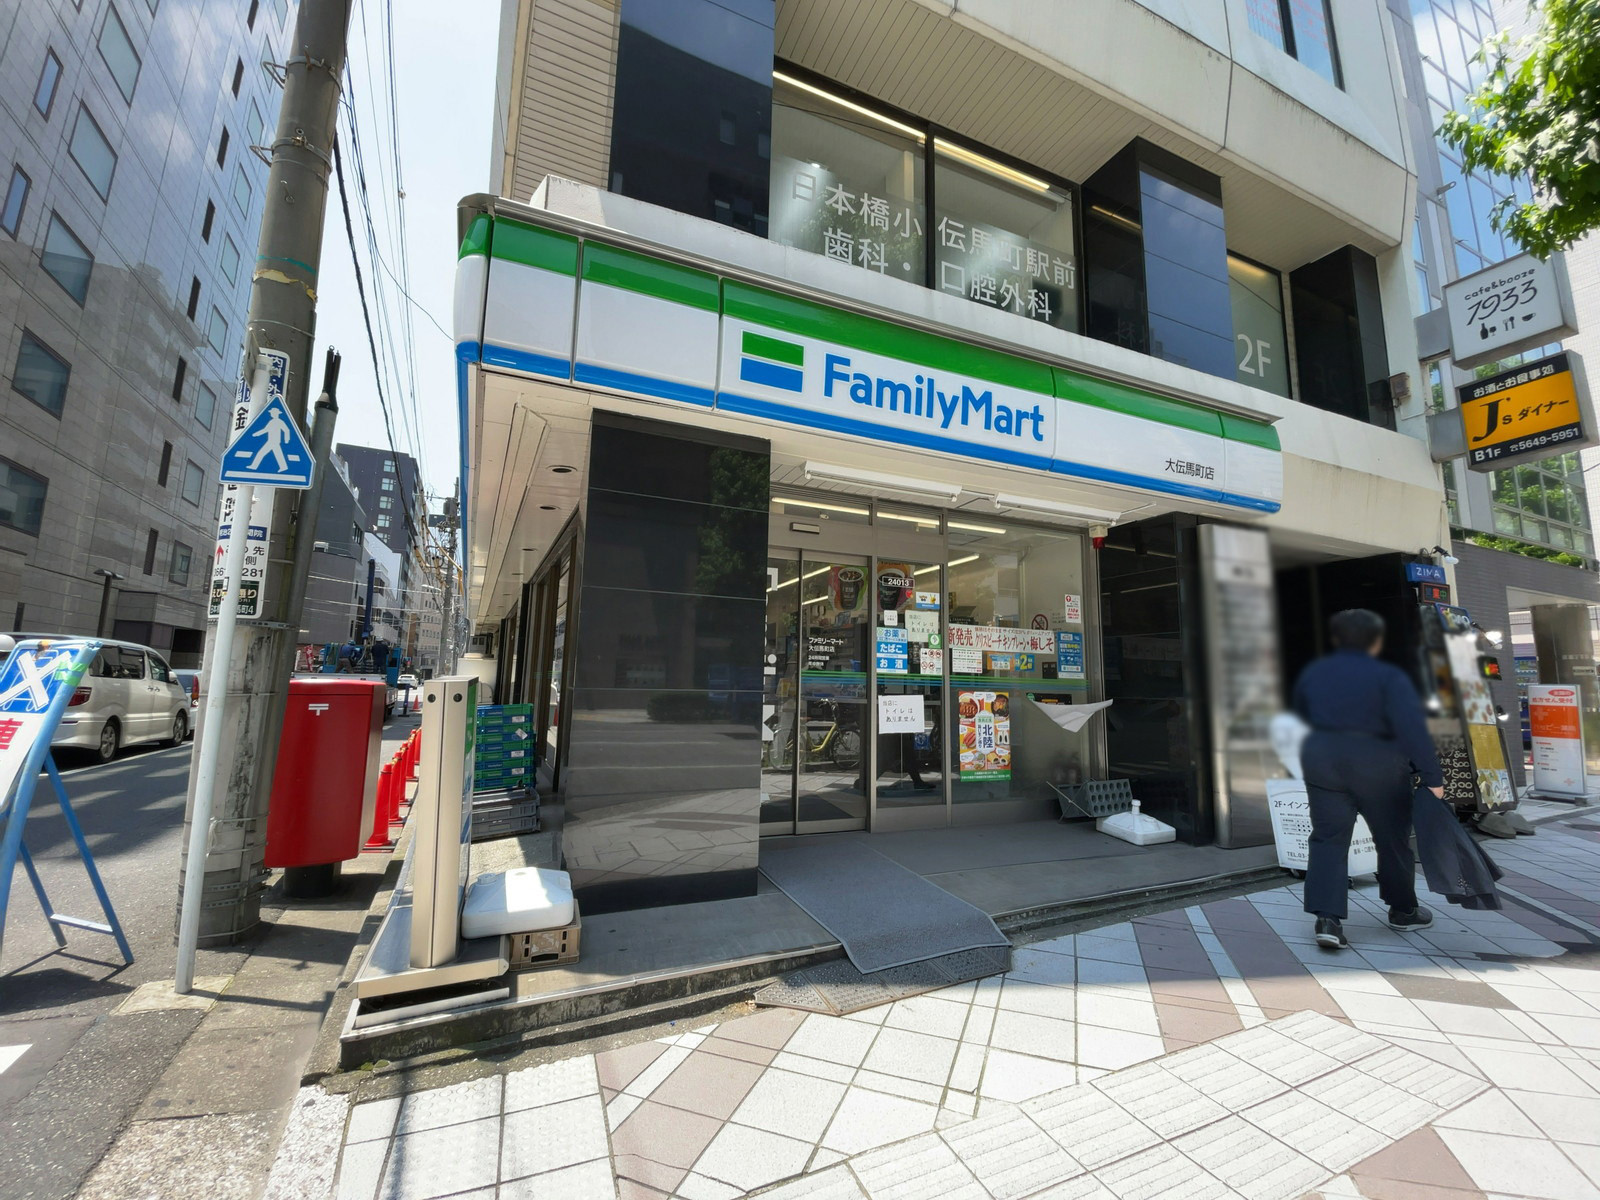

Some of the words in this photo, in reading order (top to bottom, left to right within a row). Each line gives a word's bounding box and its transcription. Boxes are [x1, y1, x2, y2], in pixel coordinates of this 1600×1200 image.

[1464, 268, 1536, 301] cafe&booze
[1466, 279, 1538, 326] 1933
[1237, 333, 1272, 377] 2F
[1473, 364, 1555, 398] お酒とお食事処
[823, 353, 1045, 442] FamilyMart
[1518, 399, 1570, 421] ダイナー
[1475, 447, 1502, 461] B1F
[1164, 457, 1215, 480] 大伝馬町店
[888, 578, 910, 586] 24013
[1416, 567, 1441, 578] ZIMA
[808, 637, 844, 645] ファミリーマート
[880, 643, 903, 653] たばこ
[880, 658, 904, 669] お酒
[886, 715, 916, 723] ありません
[982, 724, 994, 748] 北陸
